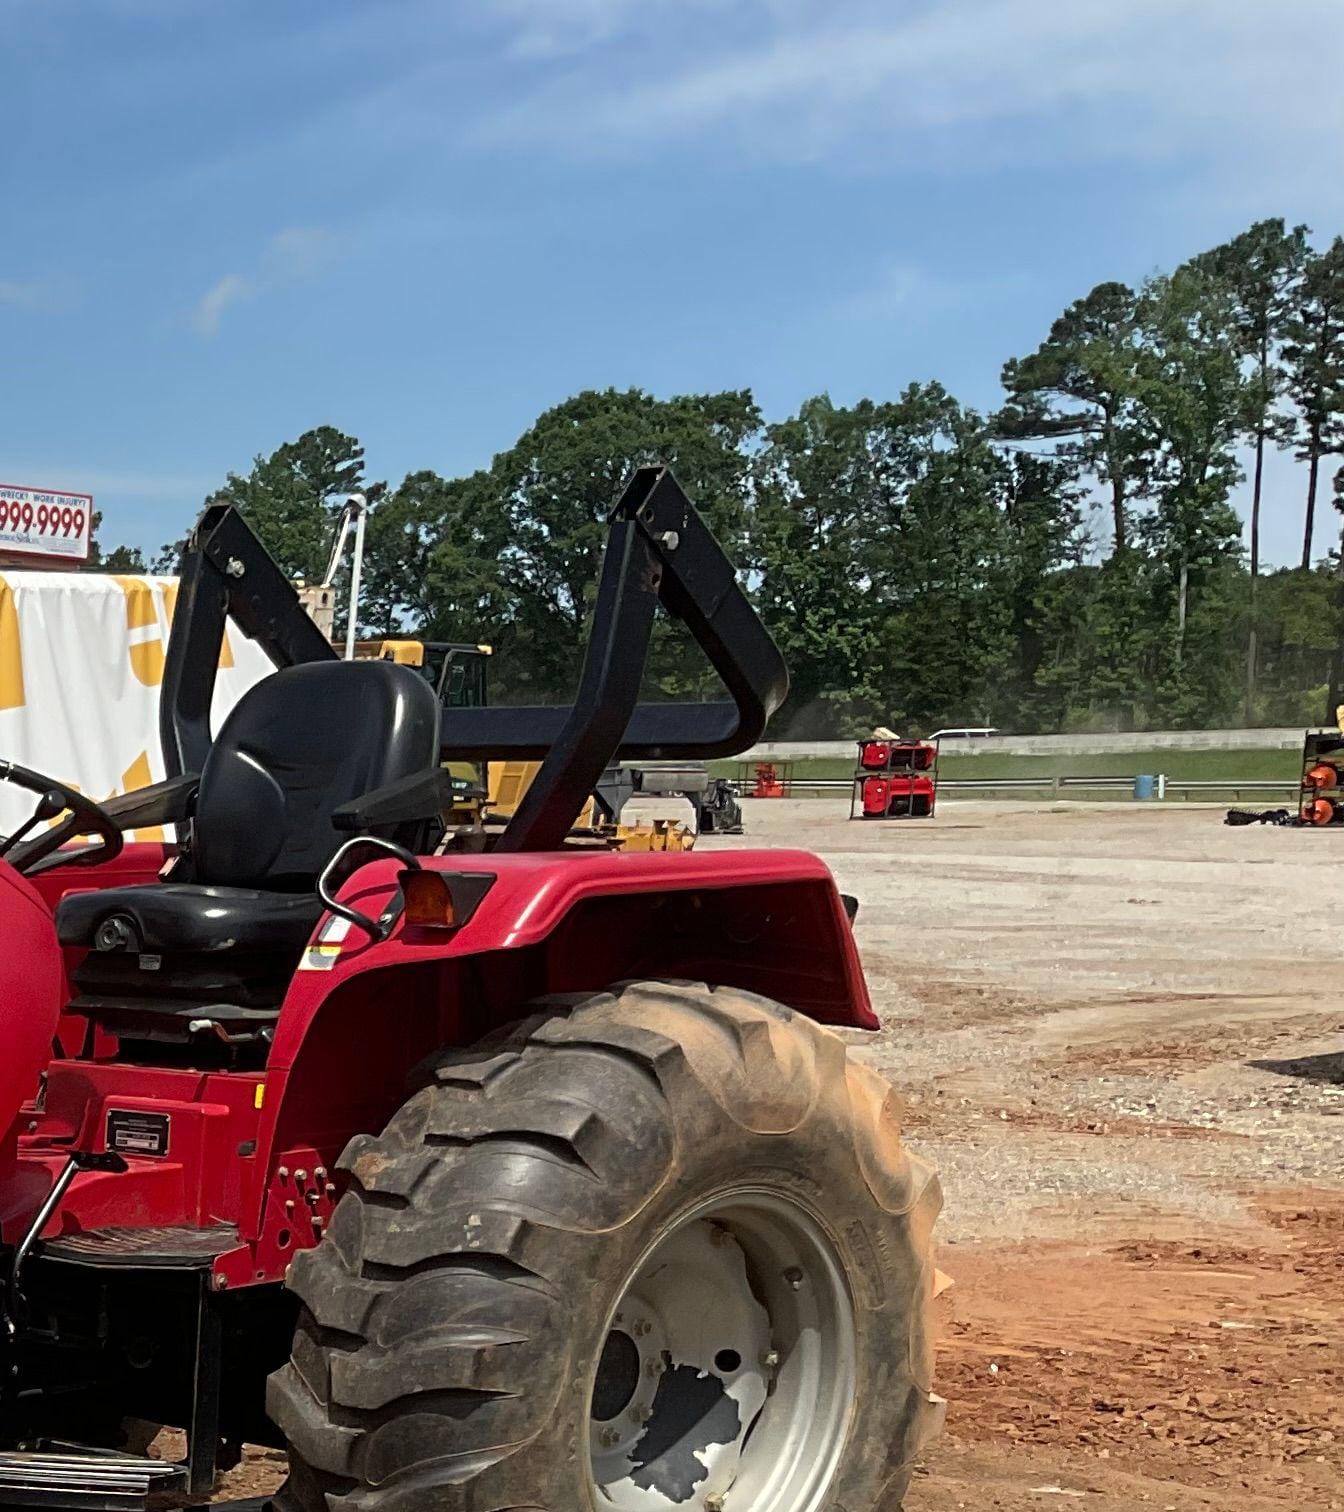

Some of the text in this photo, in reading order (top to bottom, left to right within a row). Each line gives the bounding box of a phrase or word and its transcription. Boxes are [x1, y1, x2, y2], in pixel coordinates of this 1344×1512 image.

[0, 490, 29, 500] WRECK?
[33, 493, 55, 504] WORK
[57, 496, 87, 508] INJURY?
